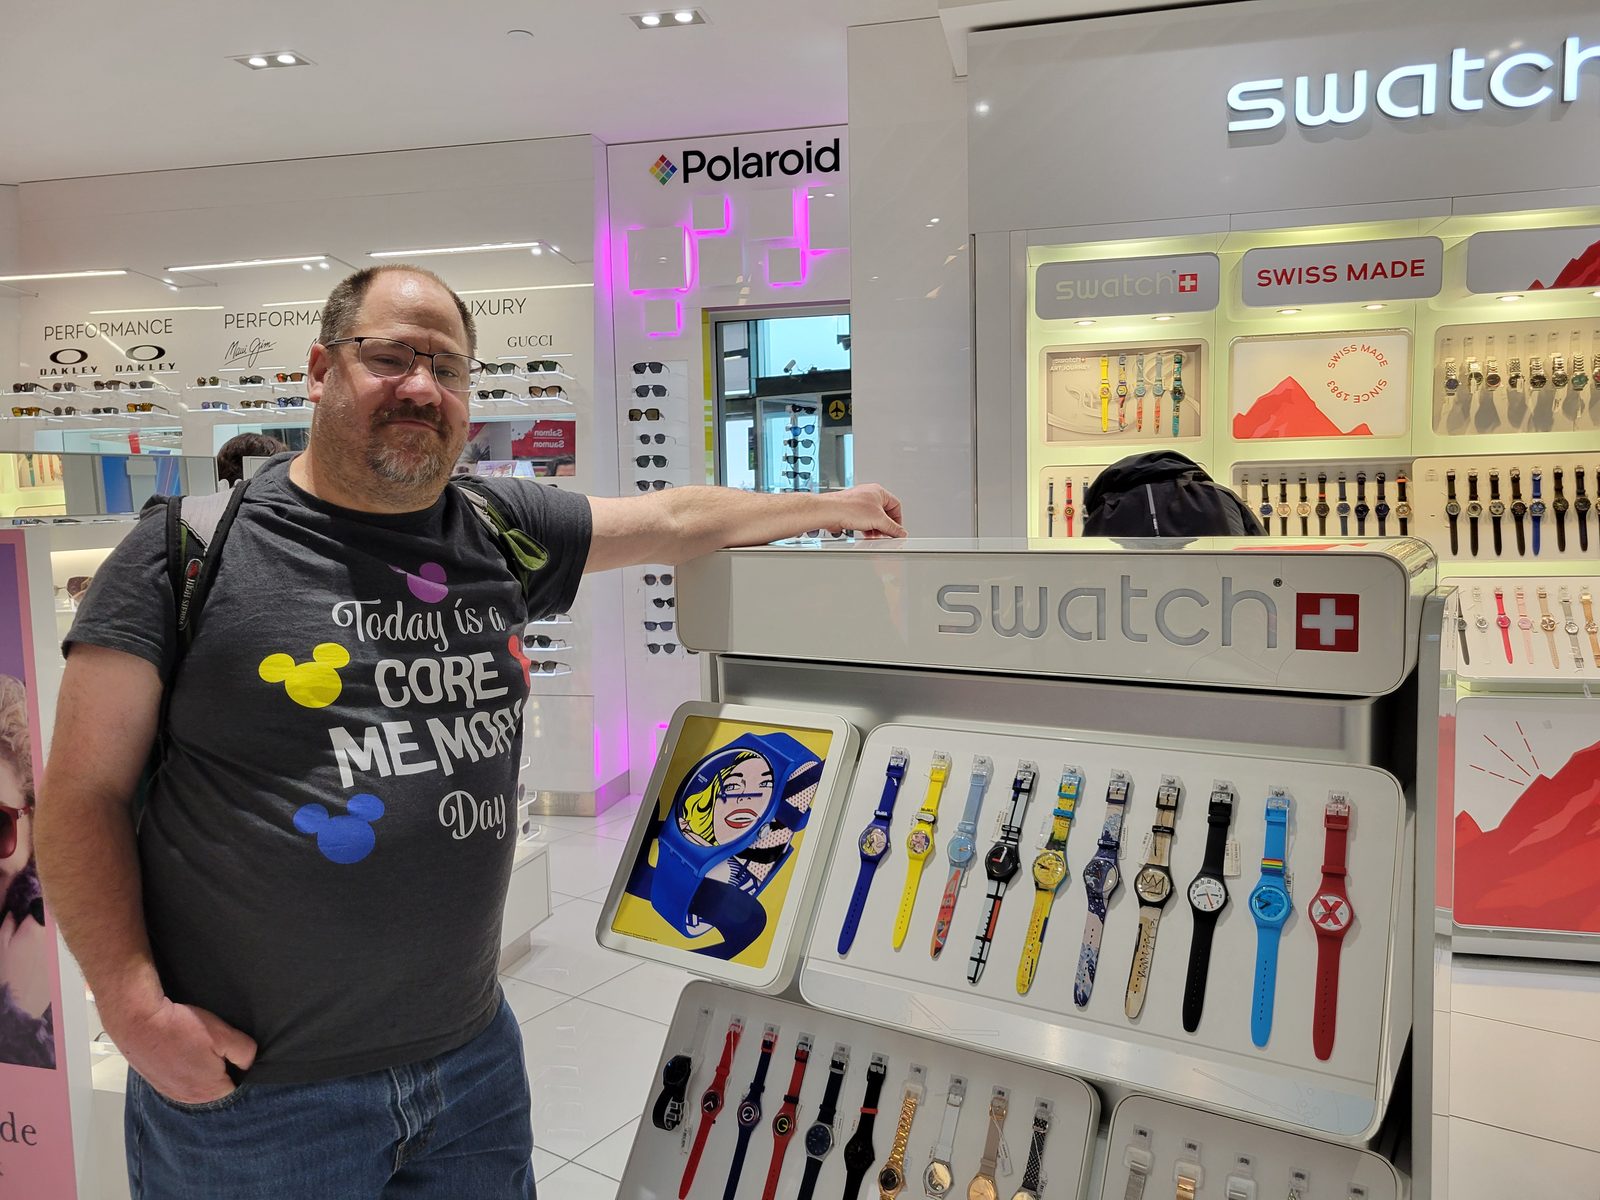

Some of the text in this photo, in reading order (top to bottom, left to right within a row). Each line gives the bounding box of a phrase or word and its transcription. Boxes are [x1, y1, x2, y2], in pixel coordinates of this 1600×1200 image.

[683, 138, 841, 183] Polaroid
[1055, 271, 1174, 300] swatch
[1257, 259, 1425, 287] SWISS MADE
[224, 310, 322, 329] PERFORMA
[470, 298, 527, 316] XURY
[44, 318, 173, 341] PERFORMANCE
[507, 334, 553, 348] GUCCI
[115, 362, 176, 372] OAKLEY
[1327, 344, 1388, 369] SWISS MADE
[40, 366, 98, 375] OAKLEY
[1327, 379, 1388, 403] SINCE 1983
[936, 574, 1278, 649] swatch
[331, 598, 506, 652] Today is a
[374, 651, 508, 709] CORE
[328, 698, 522, 789] MEMOR
[438, 790, 507, 840] Day
